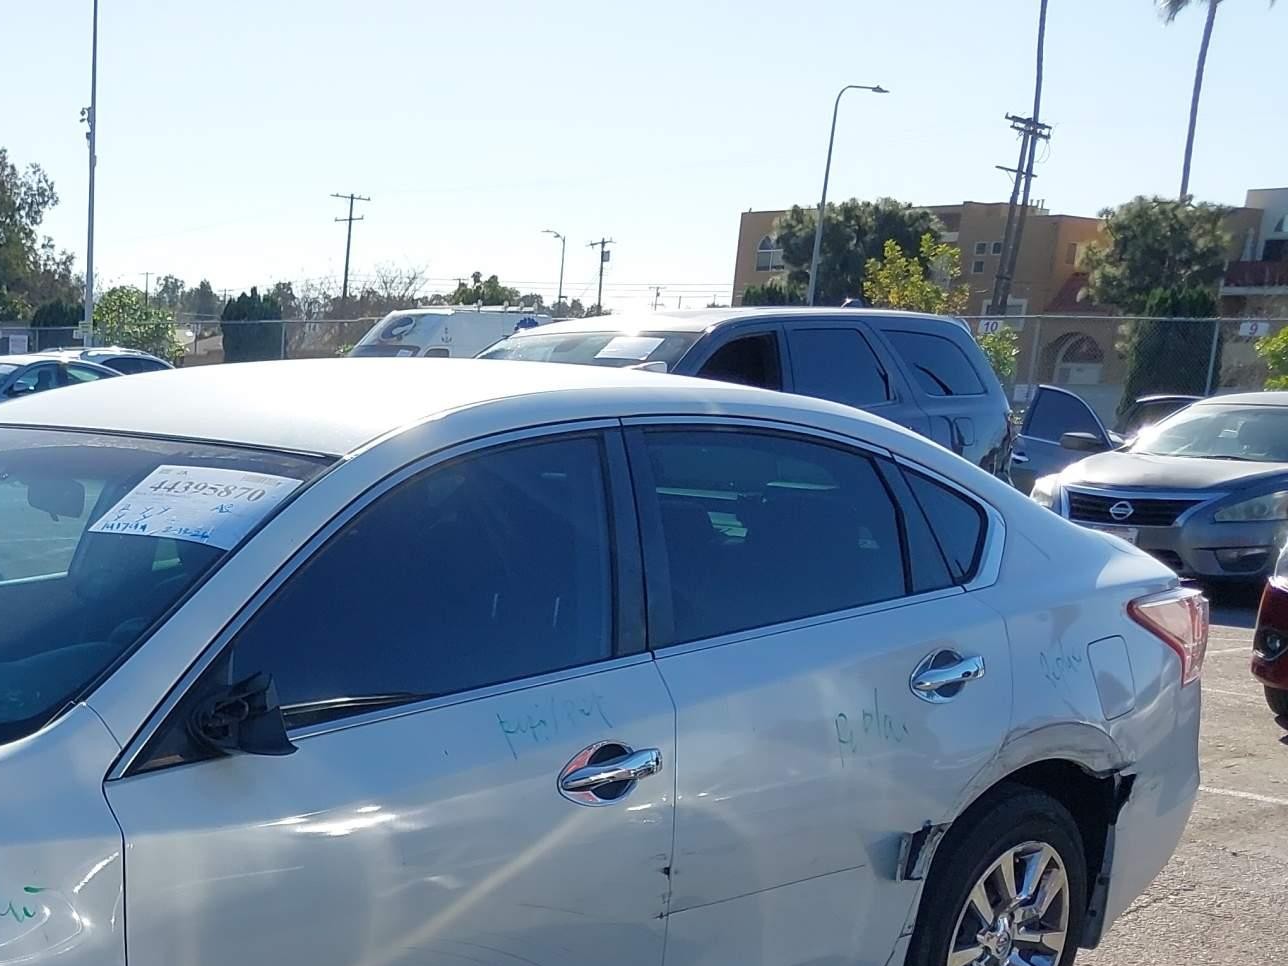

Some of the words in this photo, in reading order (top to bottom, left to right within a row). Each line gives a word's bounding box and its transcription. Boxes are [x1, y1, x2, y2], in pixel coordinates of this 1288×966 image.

[984, 321, 998, 332] 10
[1250, 321, 1257, 336] 9
[149, 479, 266, 502] 44395870
